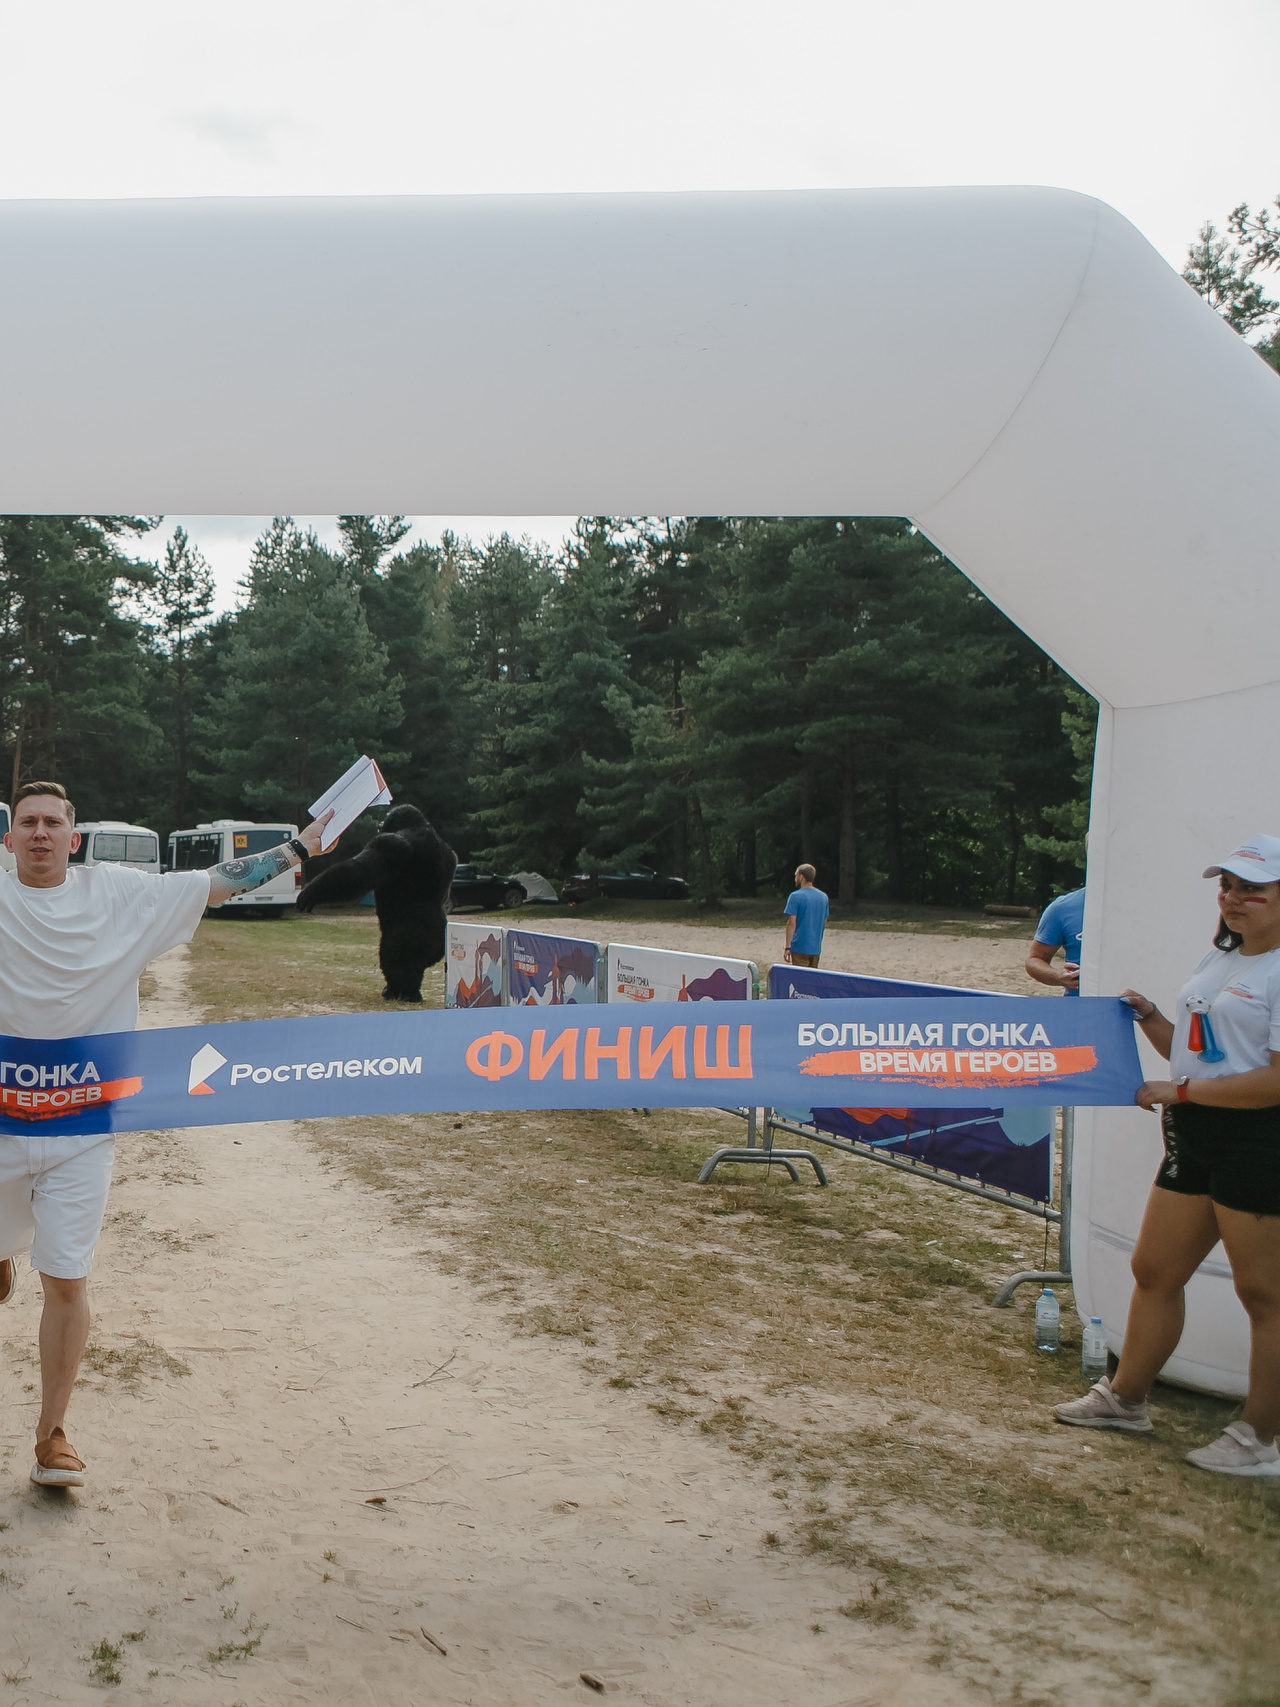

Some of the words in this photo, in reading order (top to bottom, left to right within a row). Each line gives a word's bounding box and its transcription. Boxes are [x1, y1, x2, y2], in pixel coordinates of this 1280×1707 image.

[797, 1022, 944, 1047] БОЛЬШАЯ
[951, 1022, 1052, 1047] ГОНКА
[465, 1025, 752, 1081] ФИНИШ
[859, 1050, 947, 1074] ВРЕМЯ
[953, 1050, 1058, 1074] ГЕРОЕВ
[1, 1061, 101, 1088] ГОНКА
[230, 1055, 424, 1086] Ростелеком
[2, 1086, 102, 1107] ГЕРОЕВ
